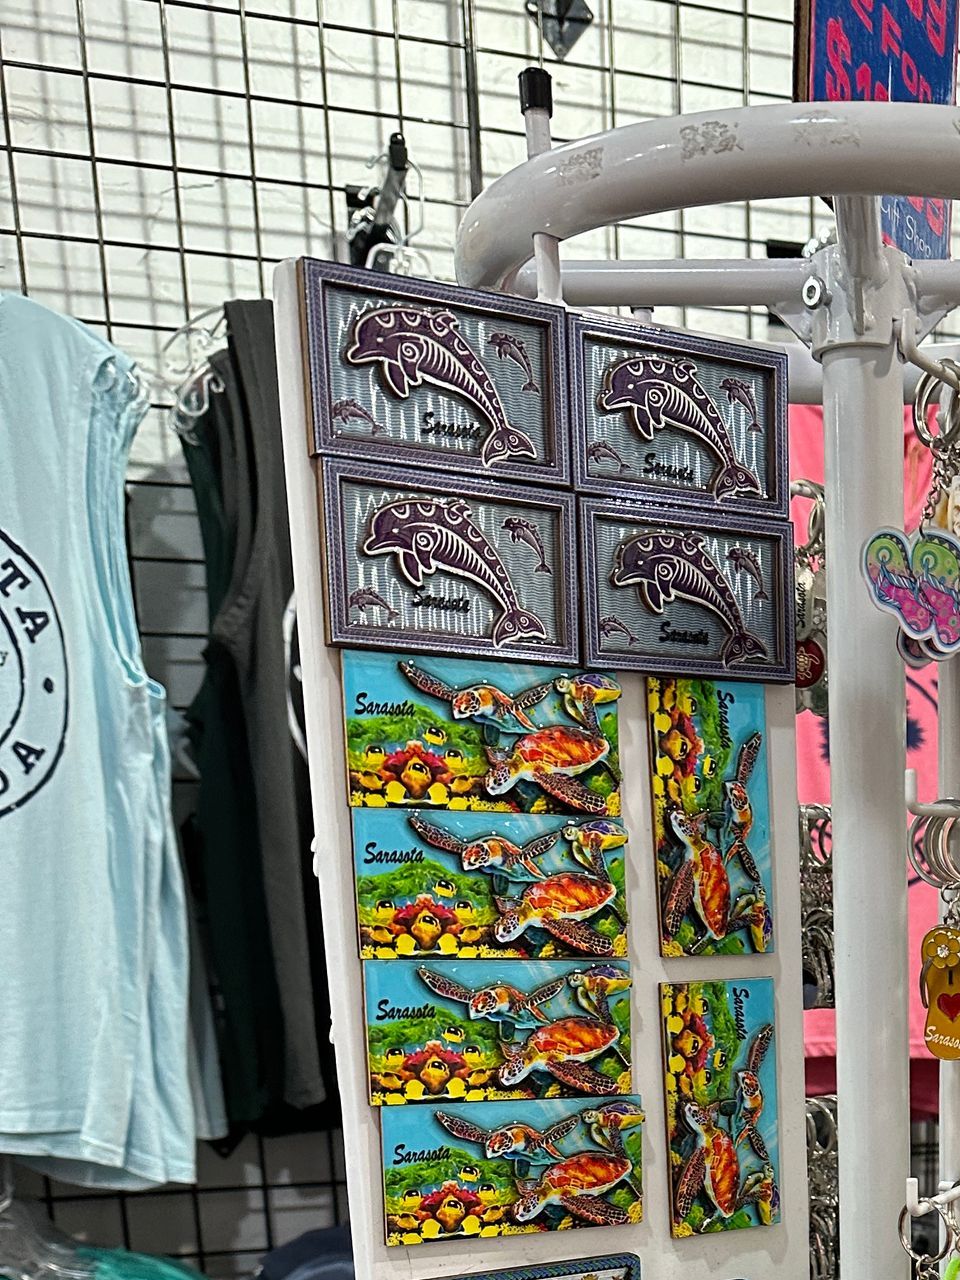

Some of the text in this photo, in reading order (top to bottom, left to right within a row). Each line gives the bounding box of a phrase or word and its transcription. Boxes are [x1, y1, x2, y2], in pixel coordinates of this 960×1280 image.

[354, 692, 416, 717] Sarasota
[717, 690, 735, 750] Sarasota
[363, 842, 425, 864] Sarasota
[376, 999, 437, 1021] Sarasota
[732, 987, 749, 1041] Sarasota
[393, 1143, 451, 1165] Sarasota
